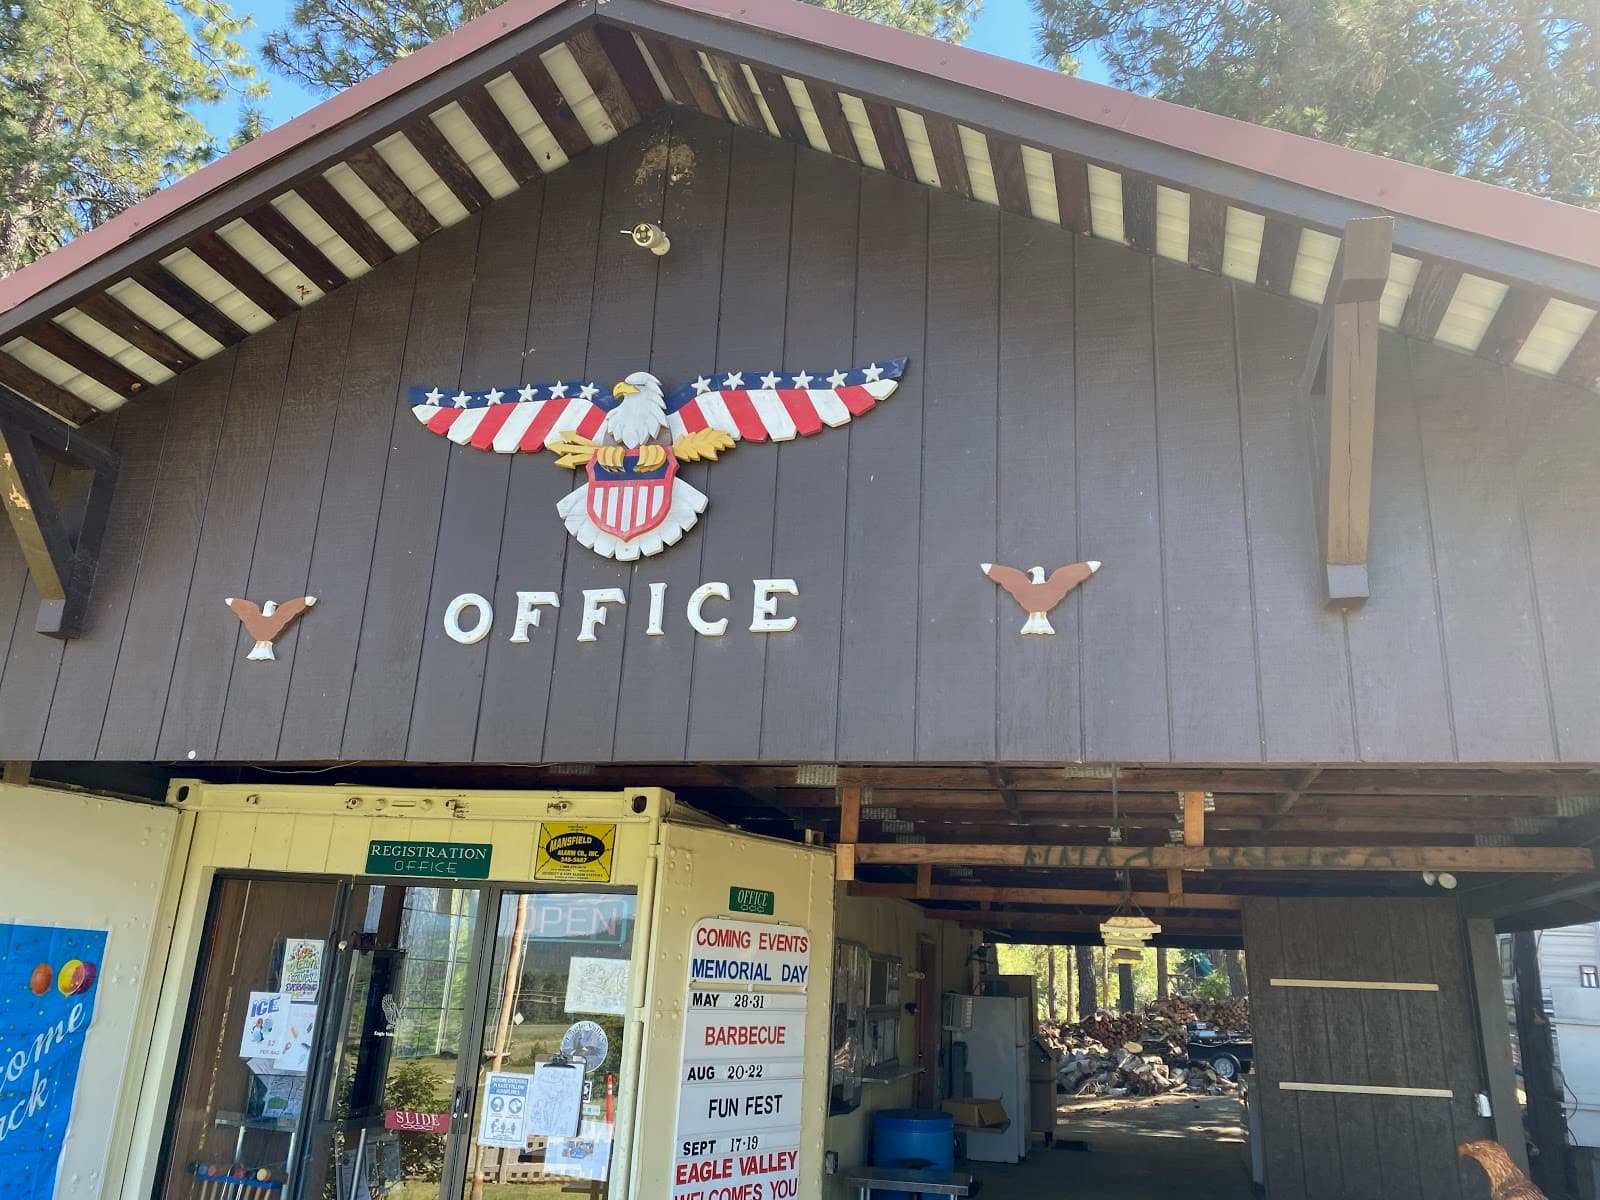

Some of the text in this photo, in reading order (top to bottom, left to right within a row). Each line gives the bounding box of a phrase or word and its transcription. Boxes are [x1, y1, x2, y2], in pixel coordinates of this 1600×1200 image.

[443, 578, 799, 645] OFFICE
[370, 844, 487, 860] REGISTRATION
[549, 836, 592, 852] MANSFIELD
[394, 860, 458, 873] OFFICE
[737, 889, 768, 907] OFFICE
[696, 927, 808, 953] COMING EVENTS
[691, 958, 808, 983] MEMORIAL DAY
[250, 996, 280, 1017] ICE
[692, 992, 720, 1008] MAY
[704, 1026, 786, 1046] BARBECUE
[687, 1066, 715, 1081] AUG
[708, 1094, 783, 1119] FUN FEST
[395, 1111, 440, 1126] SLIDE
[683, 1140, 717, 1156] SEPT
[675, 1150, 798, 1186] EAGLE VALLEY
[674, 1178, 798, 1200] COMES YOU
